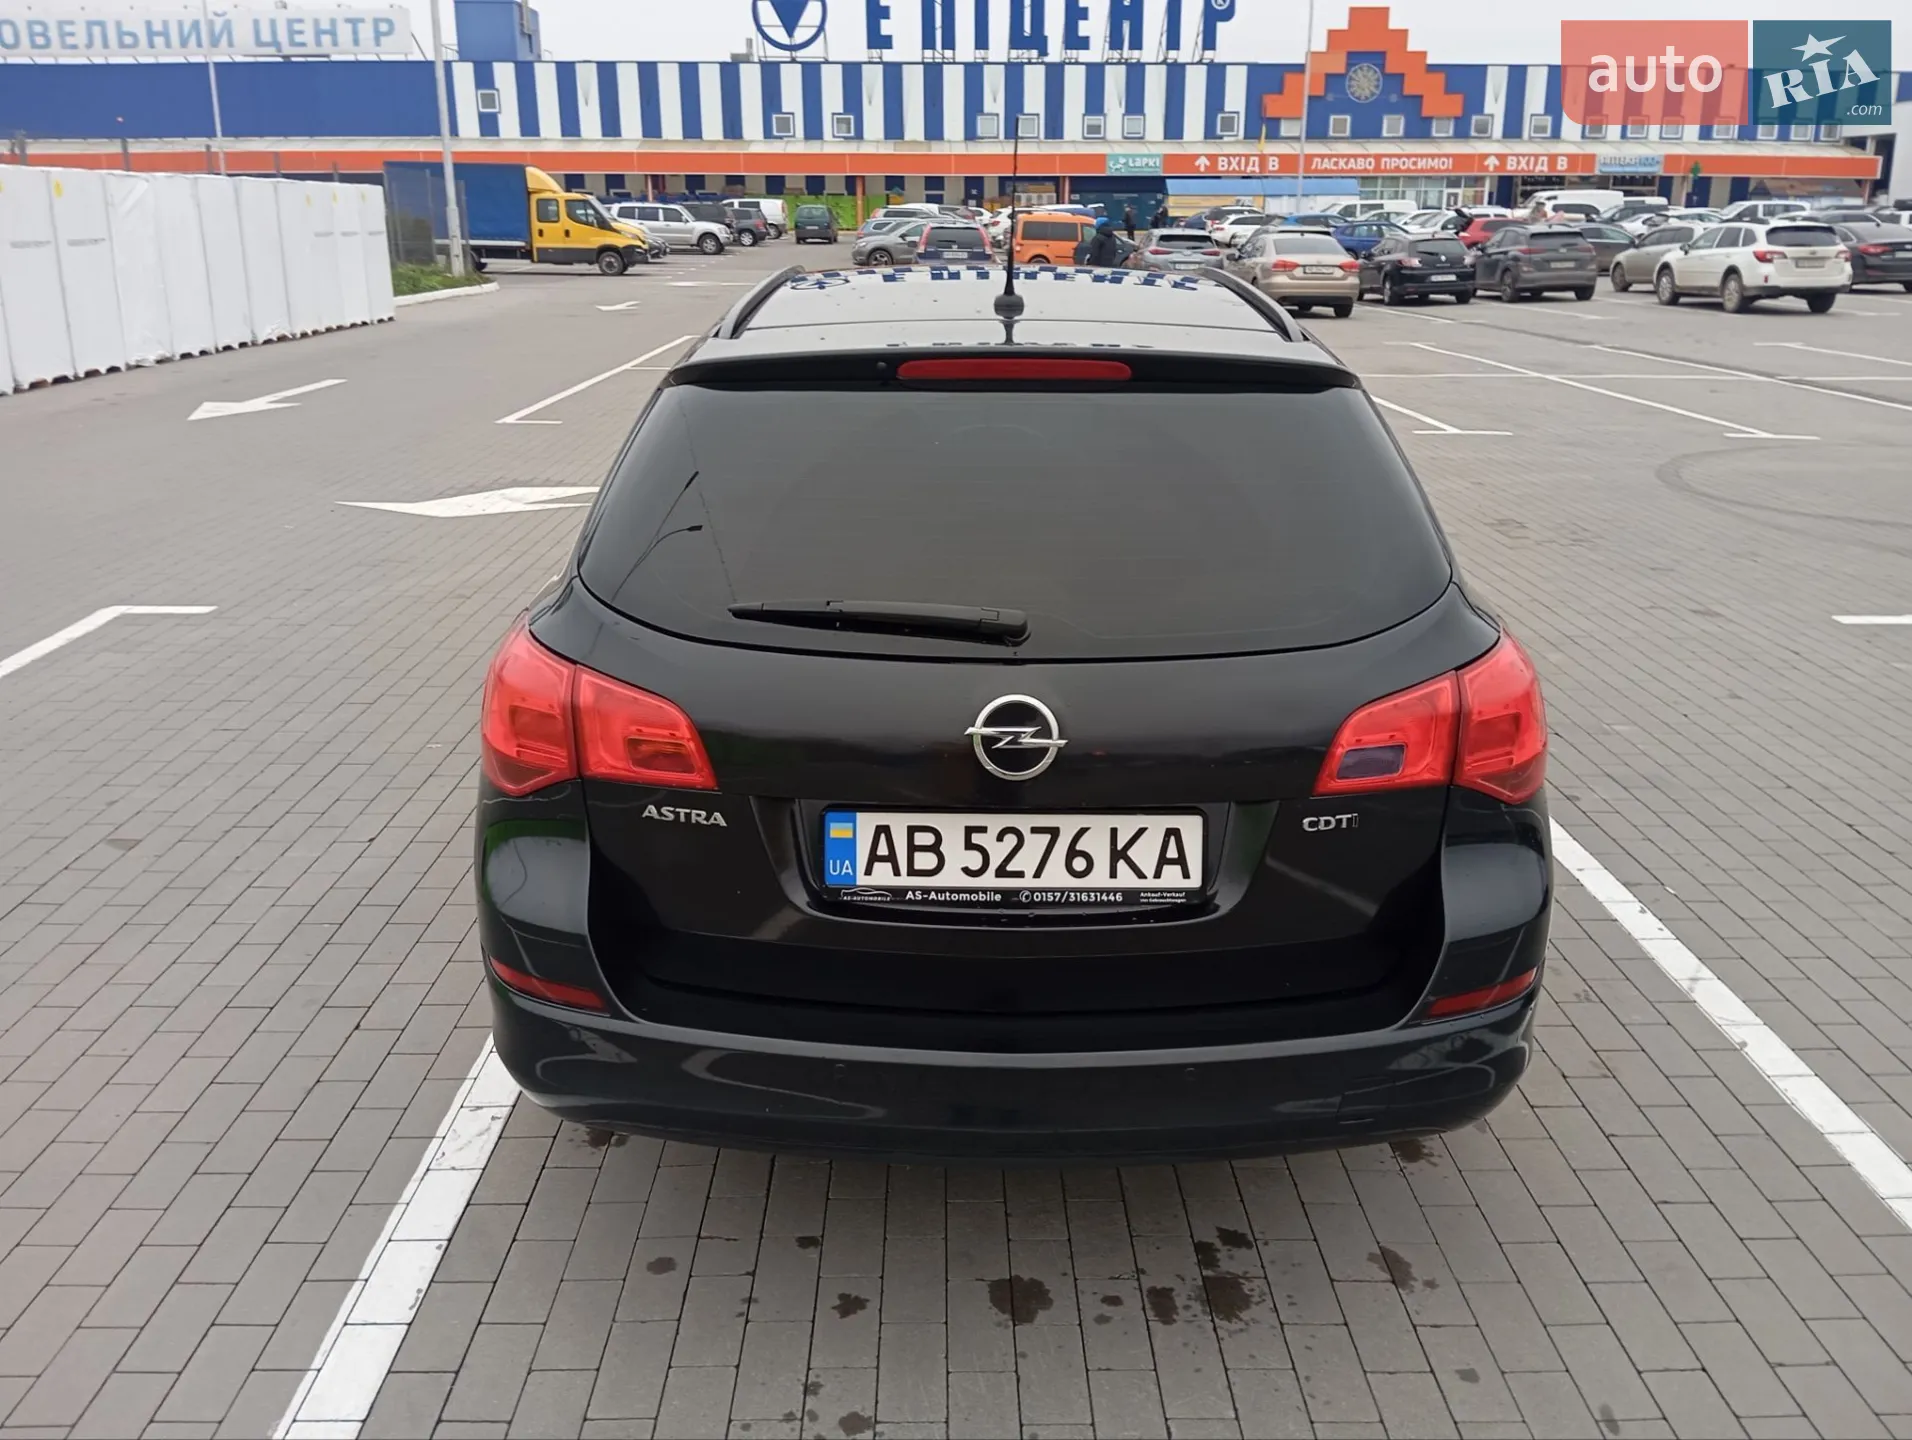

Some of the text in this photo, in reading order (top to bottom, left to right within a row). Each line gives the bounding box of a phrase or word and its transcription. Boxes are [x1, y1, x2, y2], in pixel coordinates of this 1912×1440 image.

[252, 17, 397, 54] ЦЕНТР
[1217, 156, 1280, 174] ВХІД В
[1310, 156, 1454, 171] ЛАСКАВО ПРОСИМО!
[1505, 156, 1568, 173] ВХІД В
[641, 804, 728, 828] ASTRA
[863, 824, 1192, 880] AB 5276 KA
[829, 860, 854, 876] UA
[905, 889, 1002, 903] AS-Automobile
[1032, 891, 1124, 903] 0157/31631446
